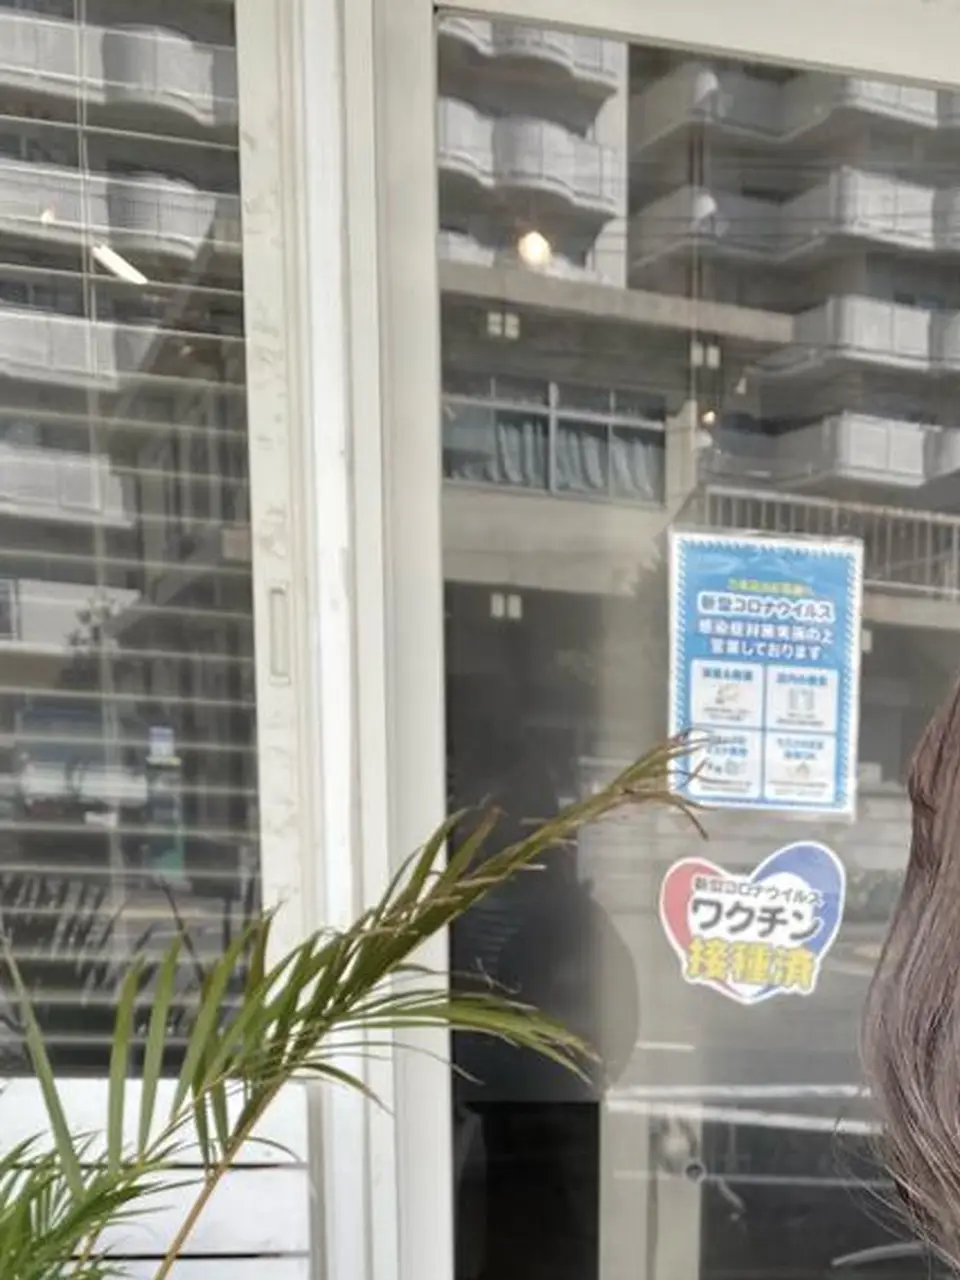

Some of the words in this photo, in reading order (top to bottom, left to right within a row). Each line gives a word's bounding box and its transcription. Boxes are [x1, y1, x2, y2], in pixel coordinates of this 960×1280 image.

[694, 876, 822, 905] 新型コロナウイルス
[691, 897, 821, 941] ワクチン
[687, 937, 816, 990] 接種済
